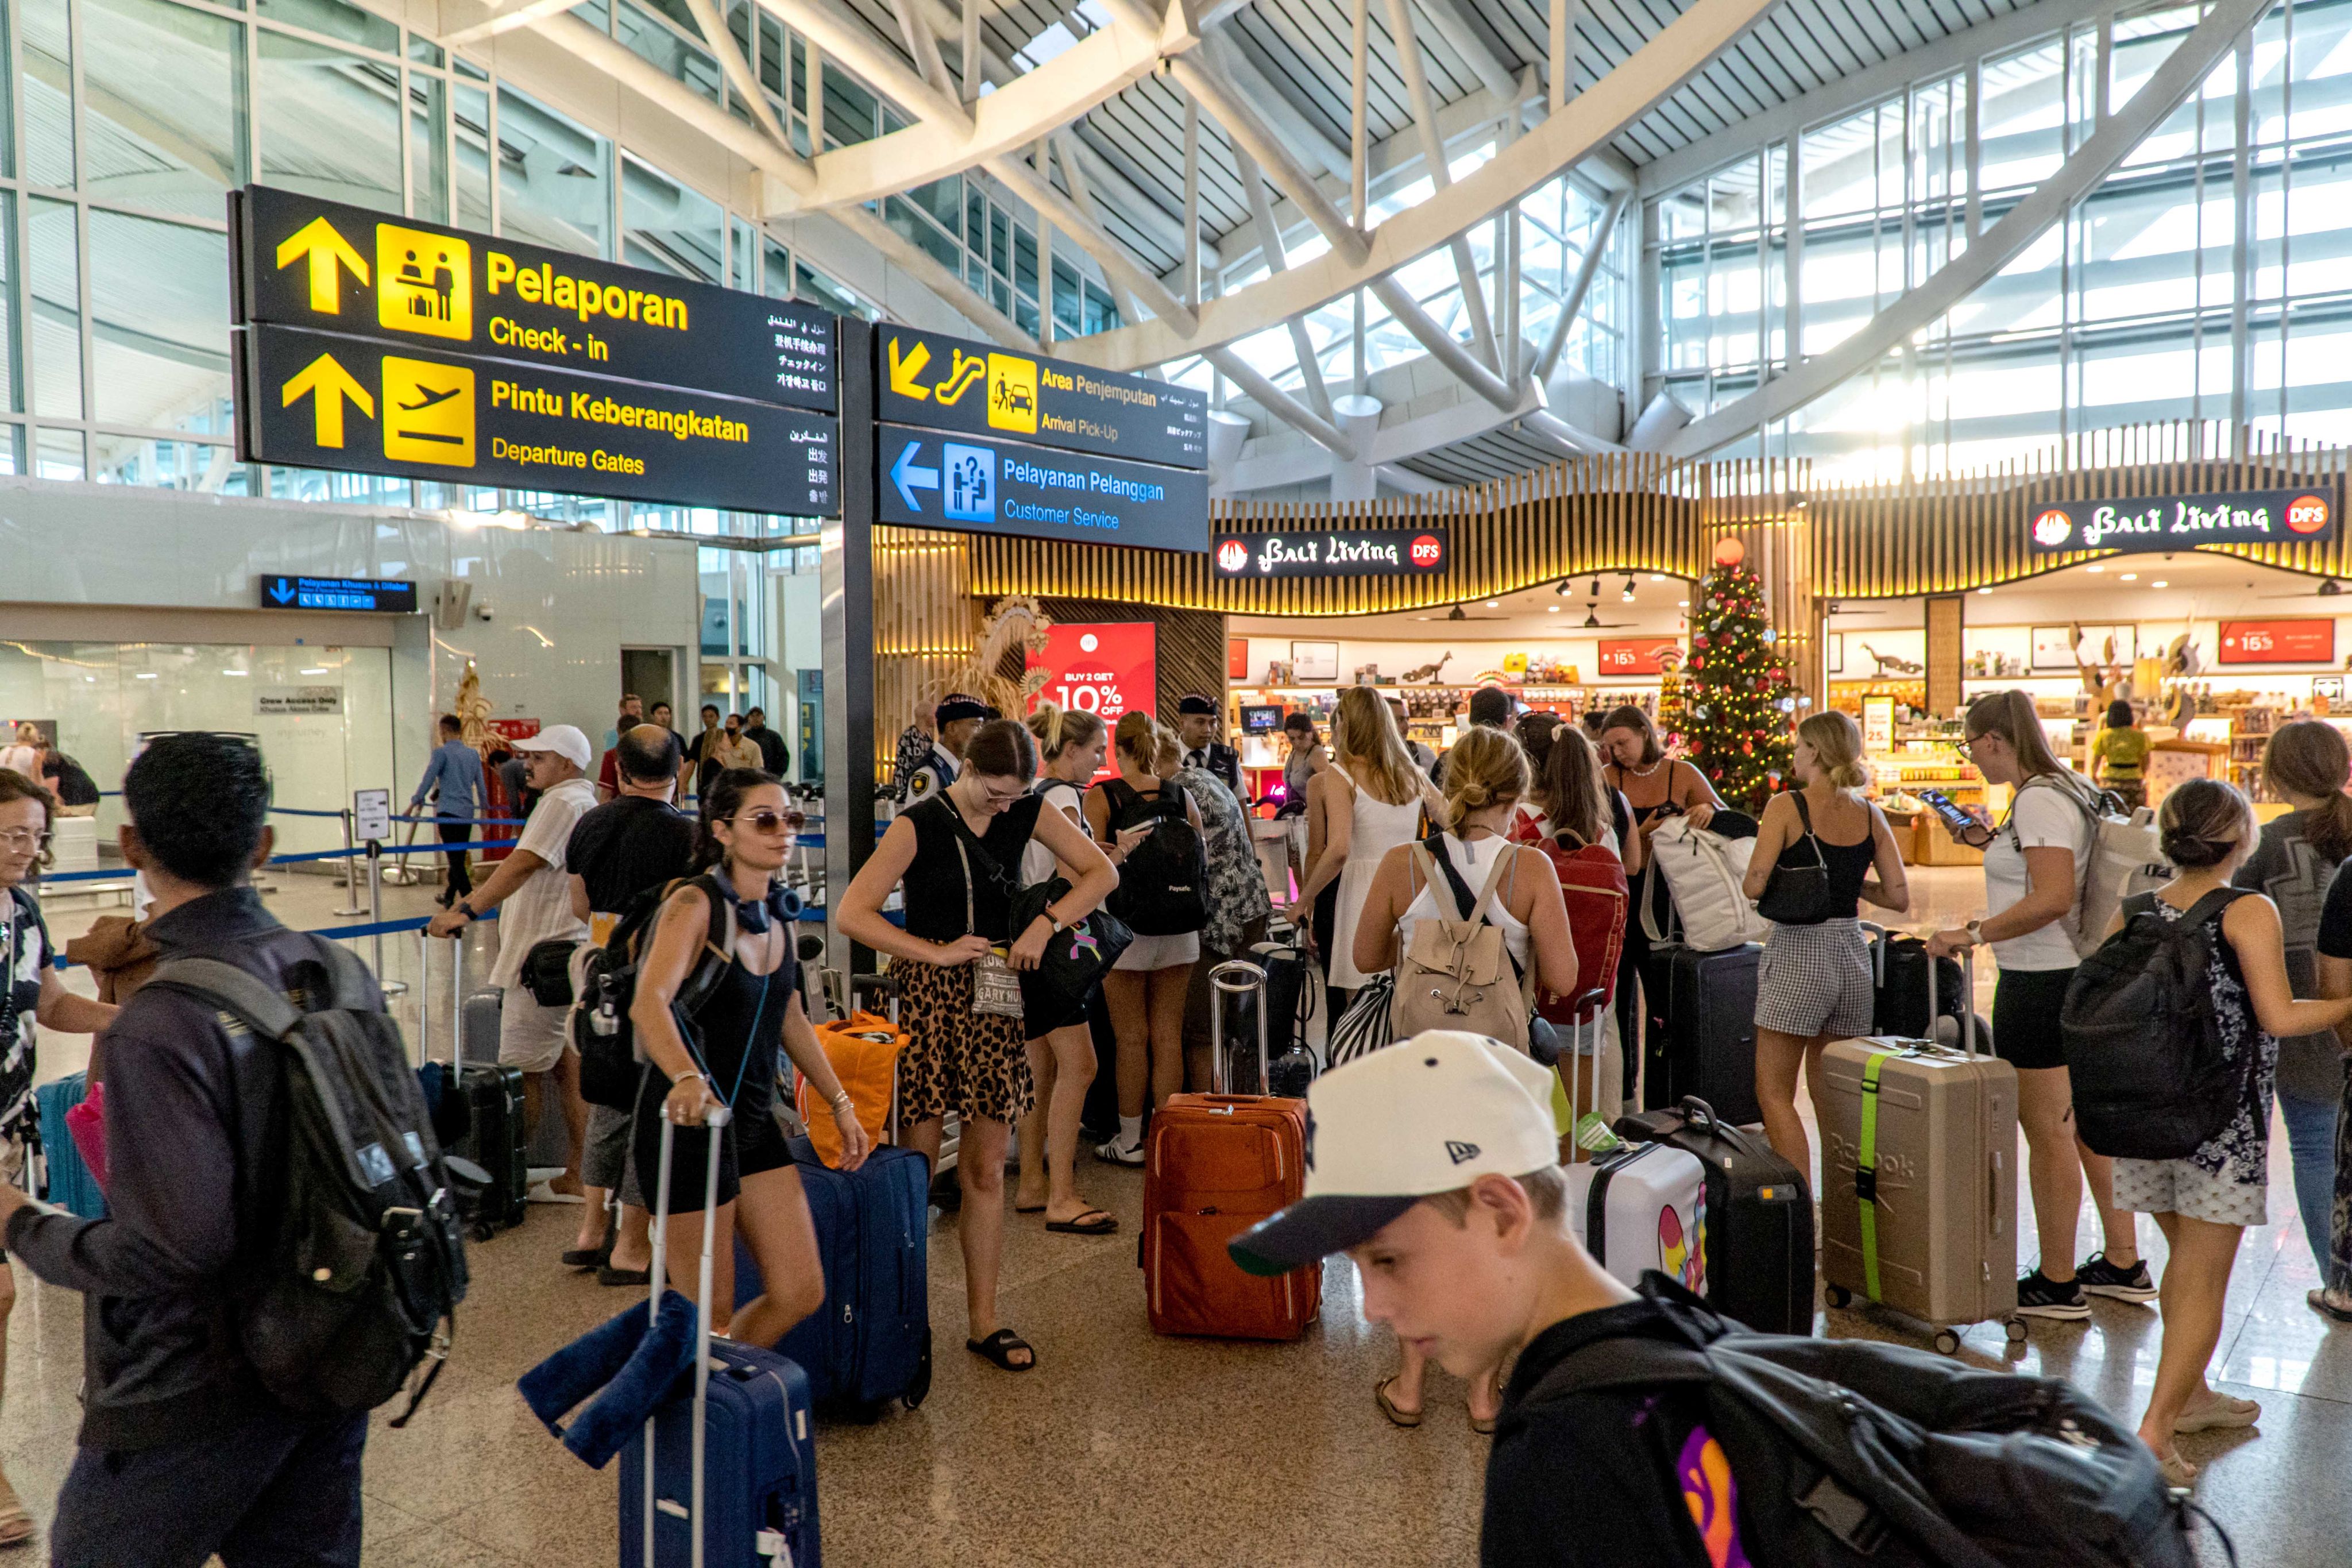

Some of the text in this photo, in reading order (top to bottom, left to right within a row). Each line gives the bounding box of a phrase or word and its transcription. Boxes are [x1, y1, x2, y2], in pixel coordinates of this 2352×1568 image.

[487, 251, 688, 331] Pelaporan
[489, 316, 567, 354] Check
[588, 334, 609, 361] in
[778, 354, 827, 373] チェックイン
[1041, 367, 1157, 408] Area Penjemputan
[492, 380, 749, 443] Pintu Keberangkatan
[1041, 413, 1118, 443] Arrival Pick-Up
[492, 437, 645, 476] Departure Gates
[808, 447, 828, 464] 出发
[808, 468, 828, 484] 出発
[1003, 459, 1164, 502] Pelayanan Pelanggan
[1005, 499, 1119, 530] Customer Service
[2170, 501, 2270, 533] Living
[2289, 507, 2324, 524] DFS
[1326, 536, 1399, 565] Living
[1413, 544, 1439, 559] DFS
[299, 577, 341, 588] Pelayanan
[1065, 673, 1114, 682] BUY 2 GET
[318, 696, 337, 705] Only
[1056, 685, 1122, 716] 10%
[1100, 706, 1124, 715] OFF
